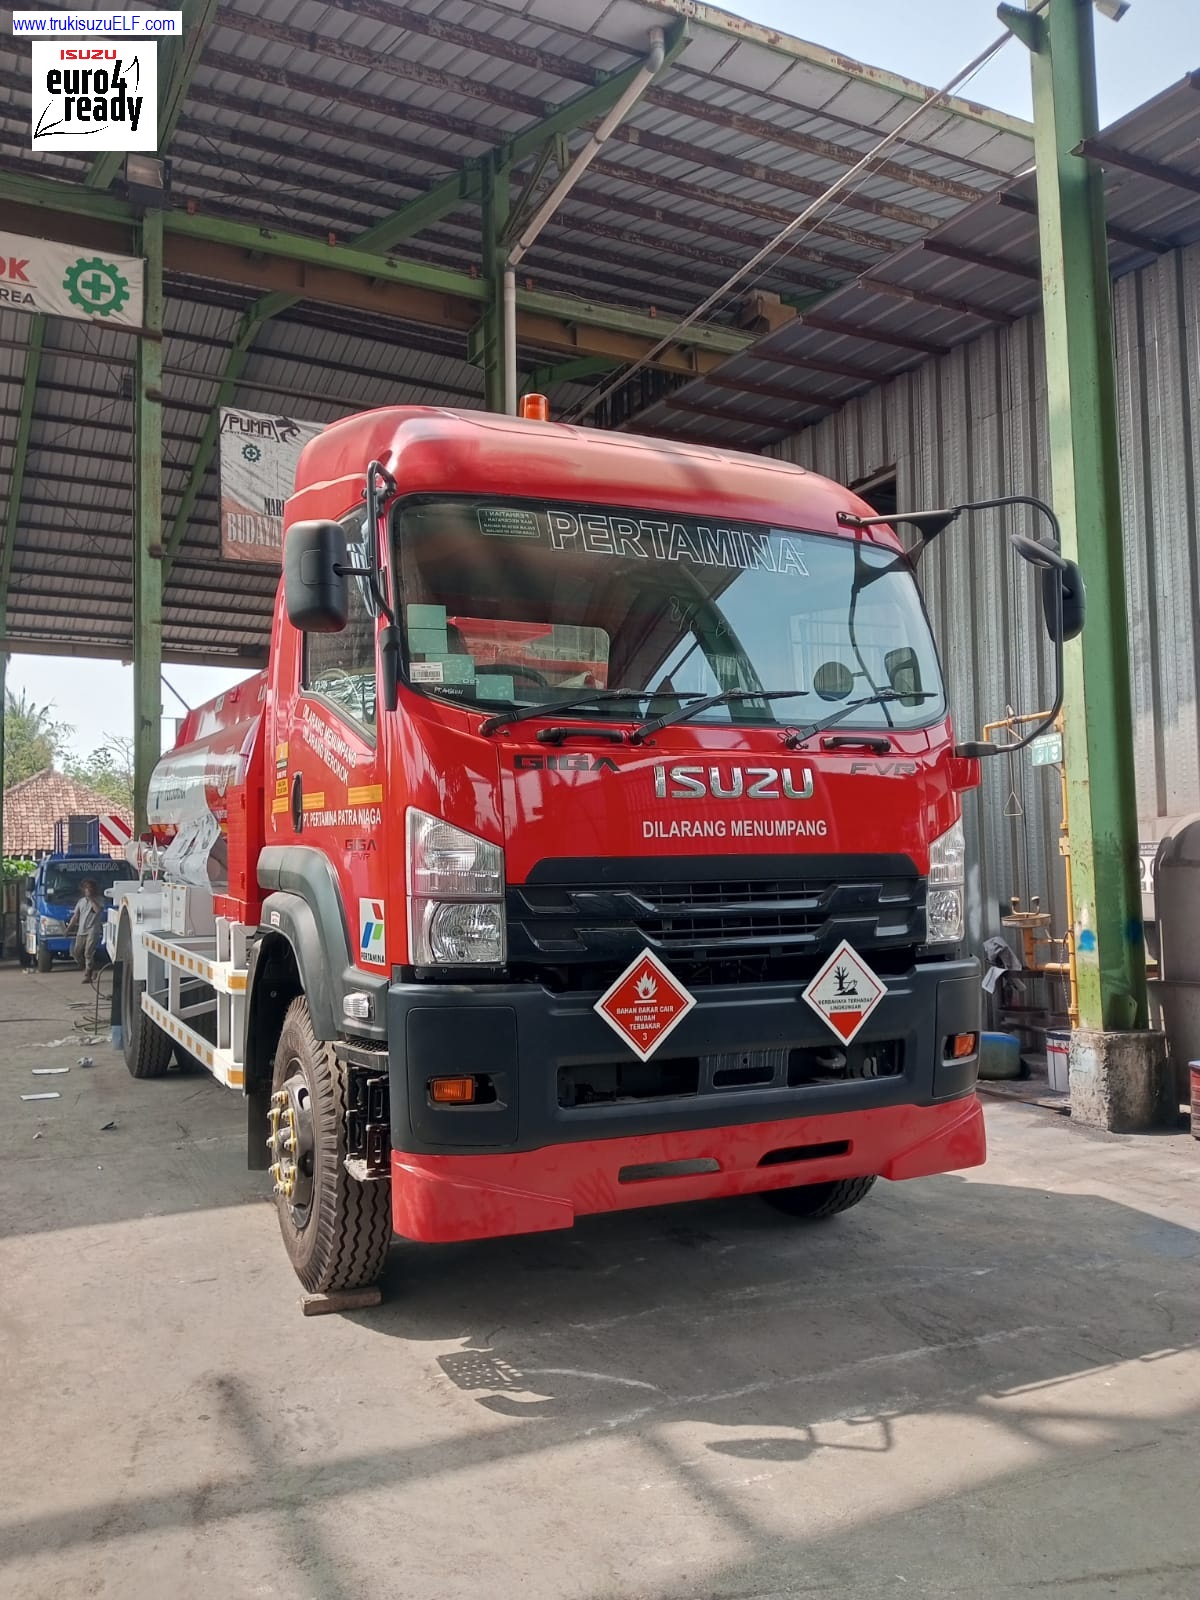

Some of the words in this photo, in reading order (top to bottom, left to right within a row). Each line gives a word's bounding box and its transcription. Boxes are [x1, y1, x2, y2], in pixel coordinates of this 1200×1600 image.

[229, 416, 271, 436] PUMA
[546, 510, 811, 577] PERTAMINA
[324, 724, 357, 768] MENUMPANG
[513, 754, 621, 772] GIGA
[848, 762, 918, 777] FVR
[653, 765, 815, 799] ISUZU
[310, 809, 337, 827] PERTAMINA
[337, 808, 358, 826] PATRA
[358, 807, 382, 825] NIAGA
[642, 819, 726, 839] DILARANG
[730, 818, 827, 838] MENUMPANG
[344, 838, 377, 851] GIGA
[616, 1007, 637, 1015] BAHAN
[659, 1005, 674, 1013] CAIR
[634, 1014, 656, 1022] MUDAH
[629, 1022, 661, 1030] TERBAKAR
[642, 1032, 648, 1041] 3
